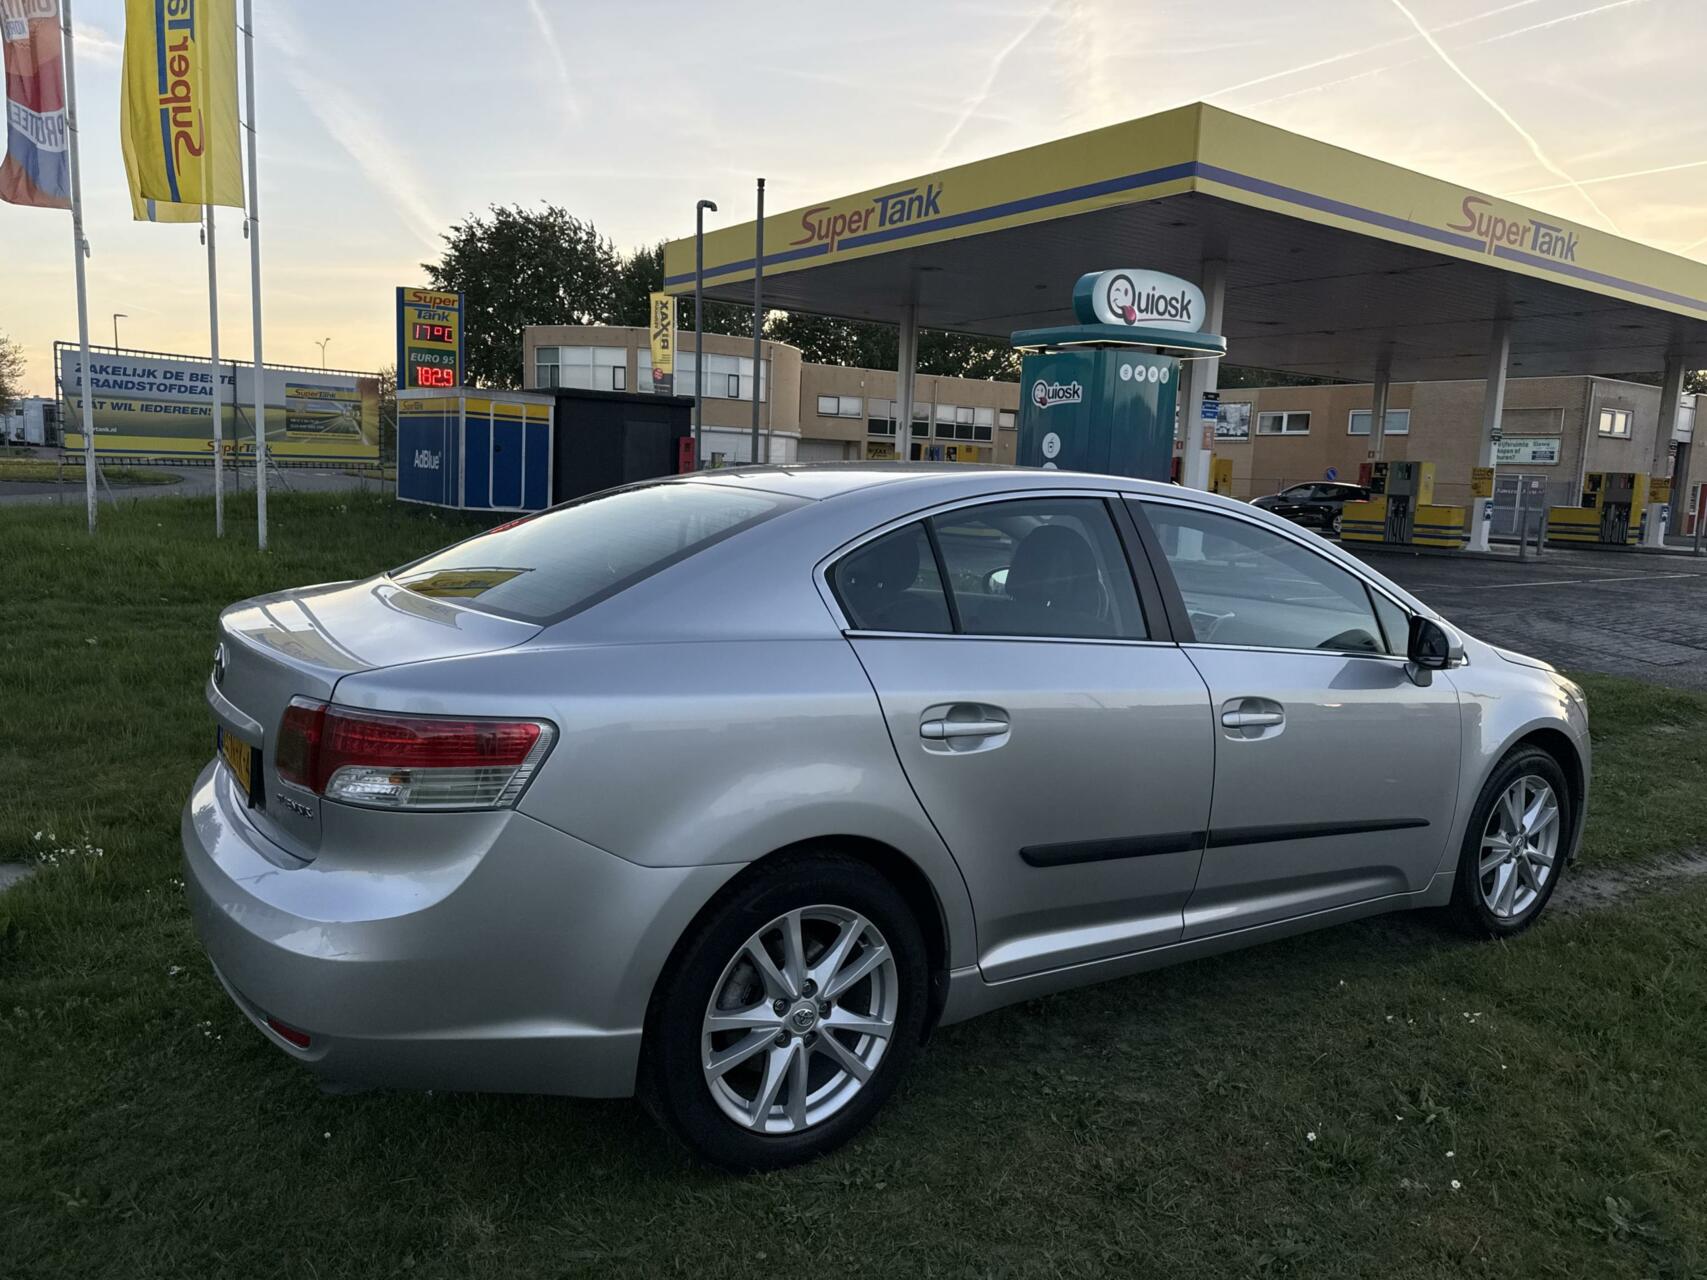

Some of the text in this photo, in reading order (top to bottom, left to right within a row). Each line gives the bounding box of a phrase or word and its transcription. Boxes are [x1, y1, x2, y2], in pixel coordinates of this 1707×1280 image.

[790, 184, 942, 253] SuperTank
[1446, 196, 1578, 262] SuperTank
[406, 291, 458, 308] Super
[1107, 274, 1191, 325] Quiosk
[414, 308, 449, 322] Tank
[410, 353, 454, 364] EURO 95
[163, 370, 184, 381] DE
[1034, 382, 1080, 406] Quiosk
[111, 402, 136, 412] WIL
